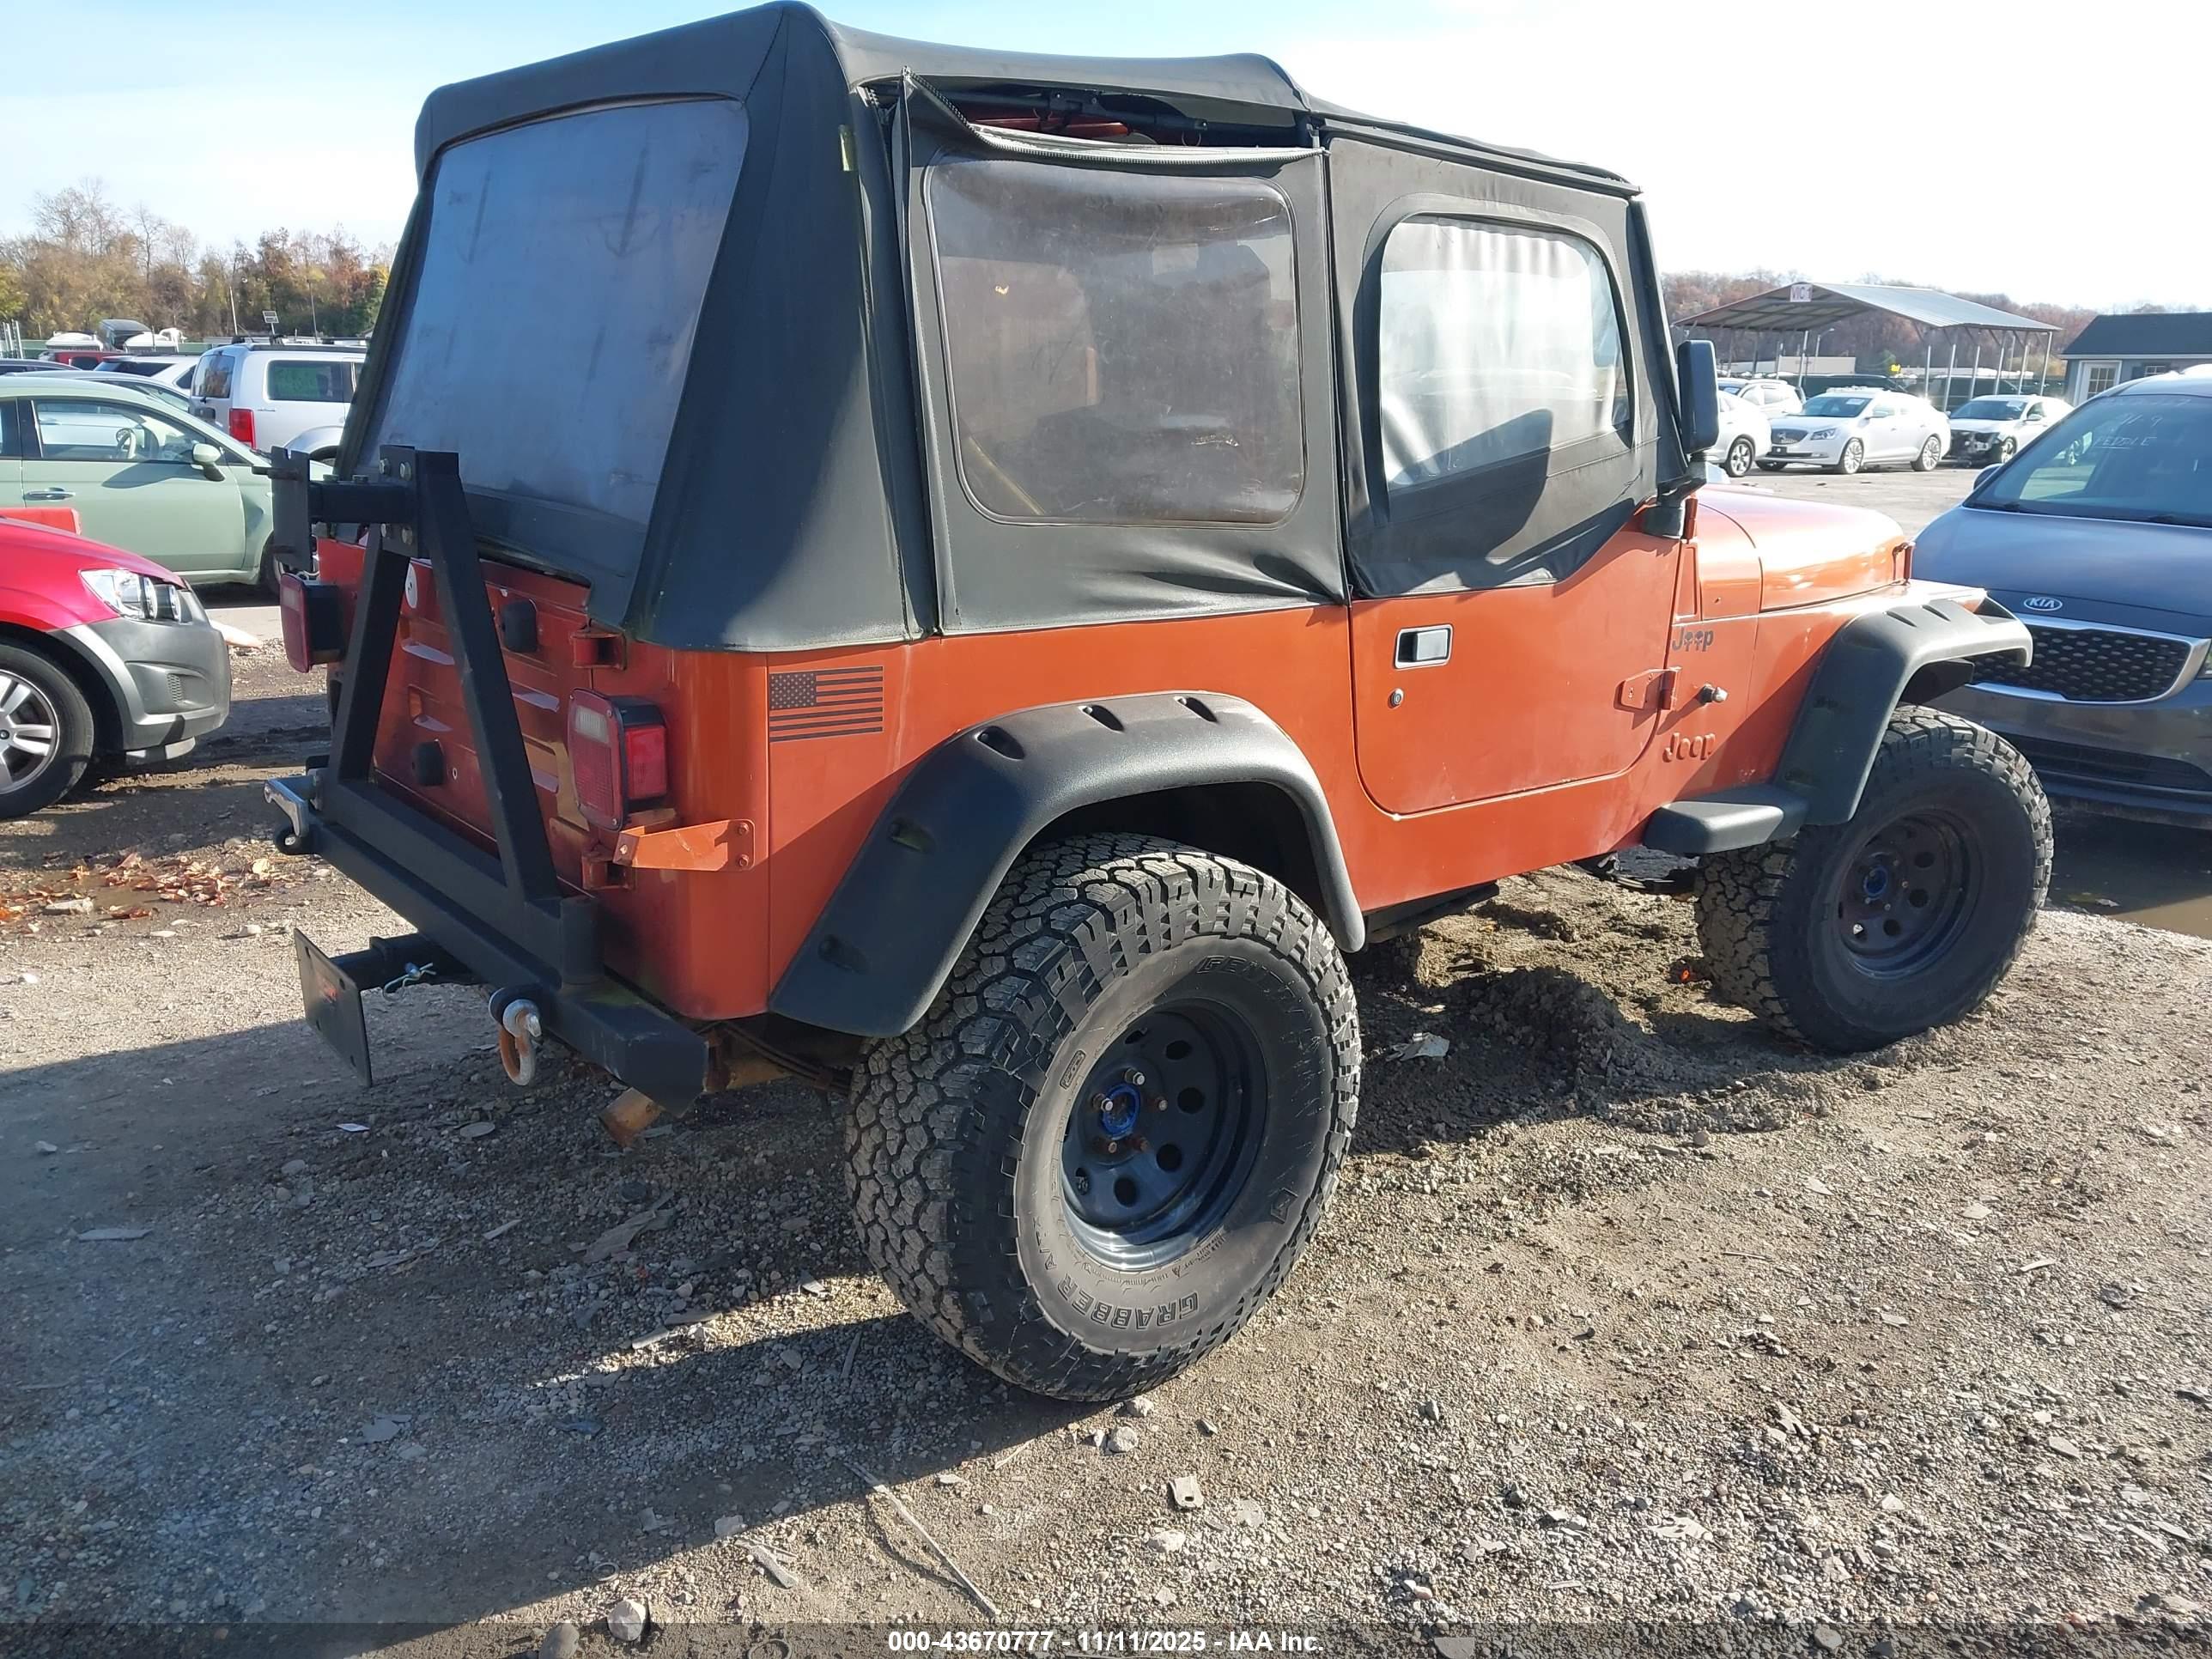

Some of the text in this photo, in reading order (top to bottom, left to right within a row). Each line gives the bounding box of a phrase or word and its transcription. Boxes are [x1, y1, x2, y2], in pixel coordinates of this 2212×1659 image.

[2029, 598, 2055, 608] KIA
[1662, 732, 1716, 763] Jeep
[1057, 1273, 1199, 1330] GRABBER
